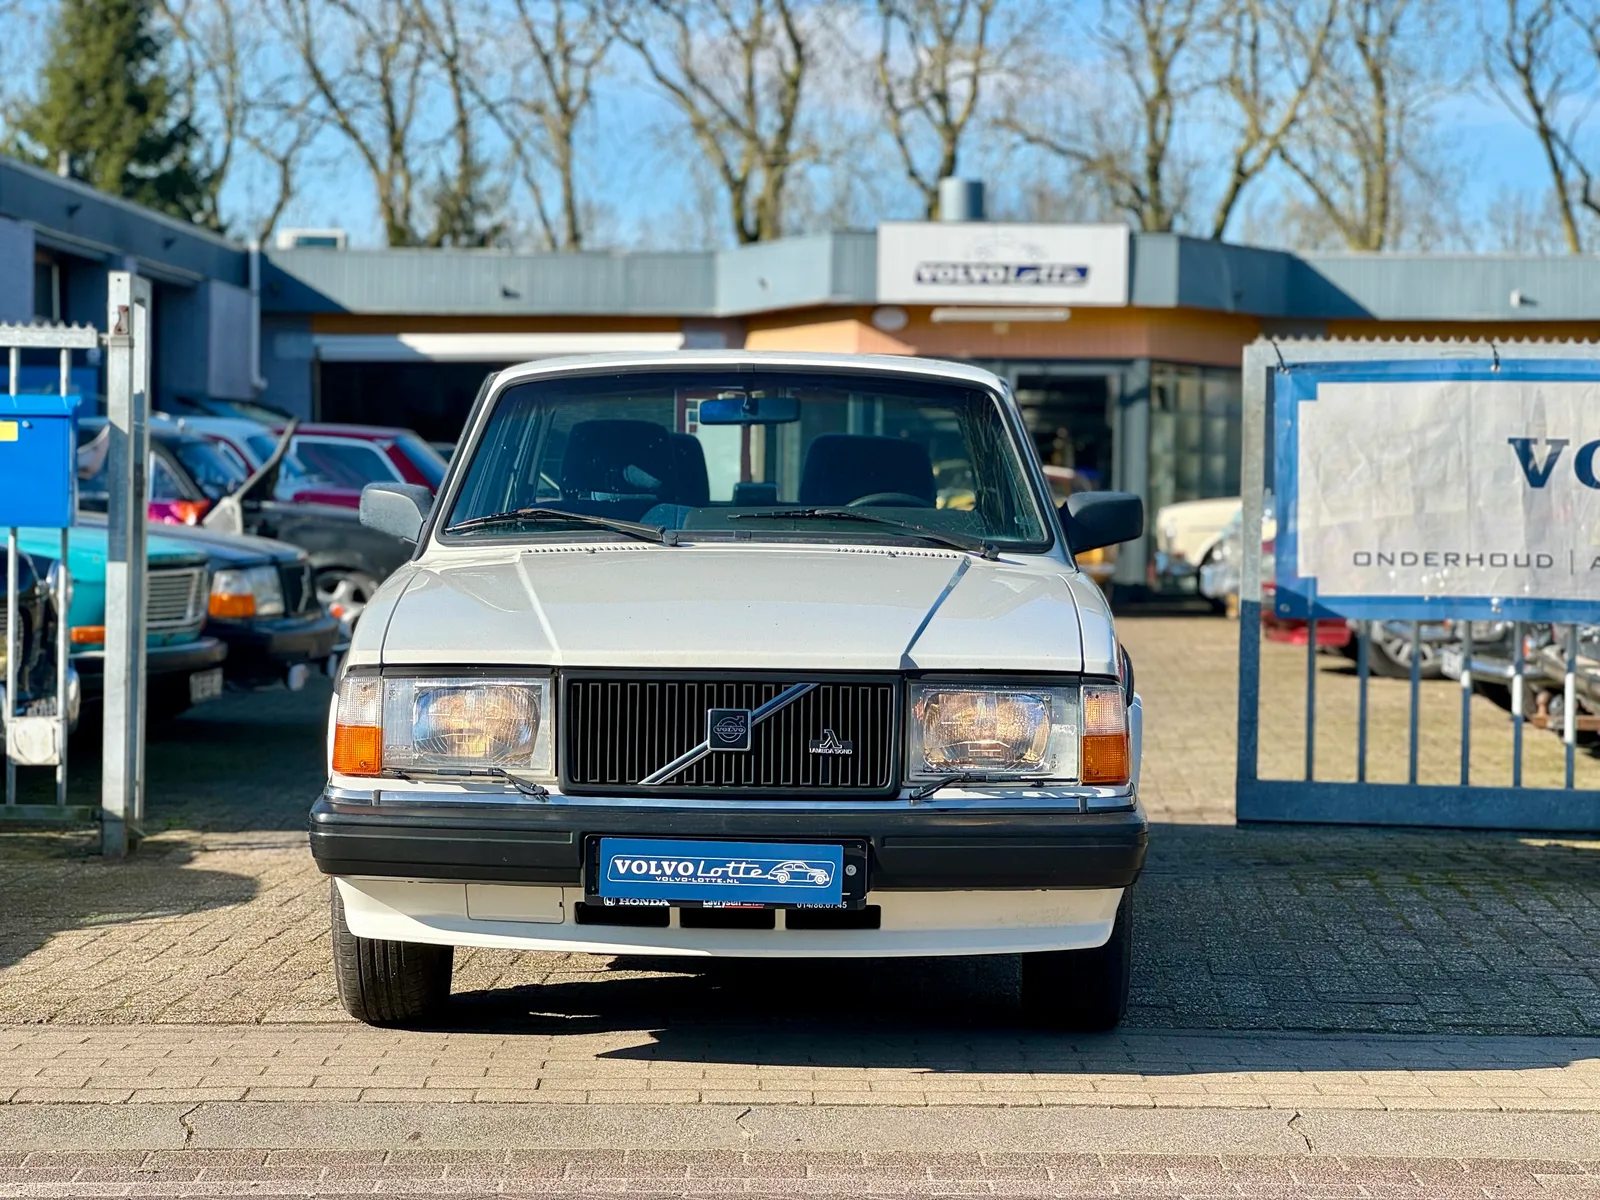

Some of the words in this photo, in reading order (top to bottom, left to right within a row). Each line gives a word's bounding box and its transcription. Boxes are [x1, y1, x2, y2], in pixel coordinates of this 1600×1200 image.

[918, 265, 1004, 283] VOLVO
[1353, 552, 1554, 568] ONDERHOUD
[614, 859, 694, 876] VOLVO
[697, 860, 764, 878] Lotte
[619, 897, 670, 906] HONDA
